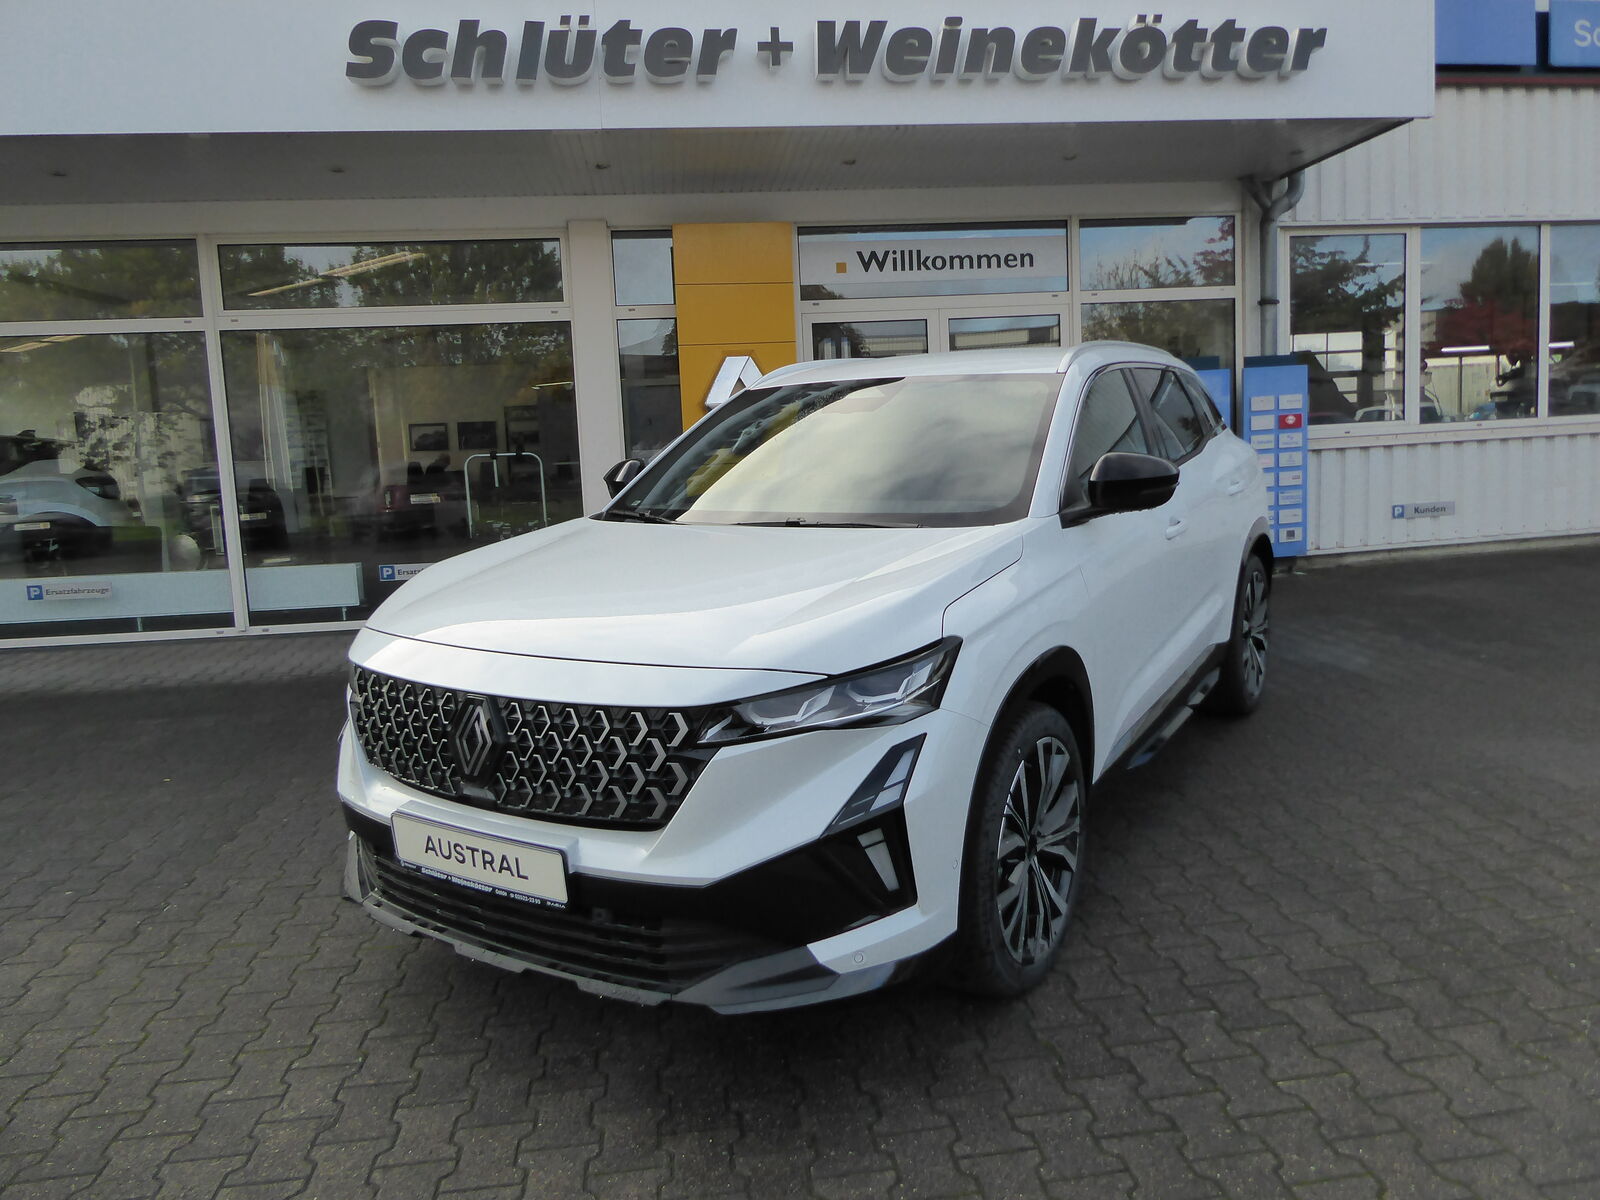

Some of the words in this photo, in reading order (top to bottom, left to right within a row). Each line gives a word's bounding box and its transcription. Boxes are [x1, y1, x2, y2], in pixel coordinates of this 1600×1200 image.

[346, 15, 738, 86] Schlüter
[757, 26, 793, 69] +
[815, 14, 1327, 82] Weinekötter
[856, 249, 1034, 273] Willkommen
[1414, 506, 1446, 514] Kunden
[45, 587, 109, 596] Ersatzfahrzeuge
[424, 835, 529, 881] AUSTRAL
